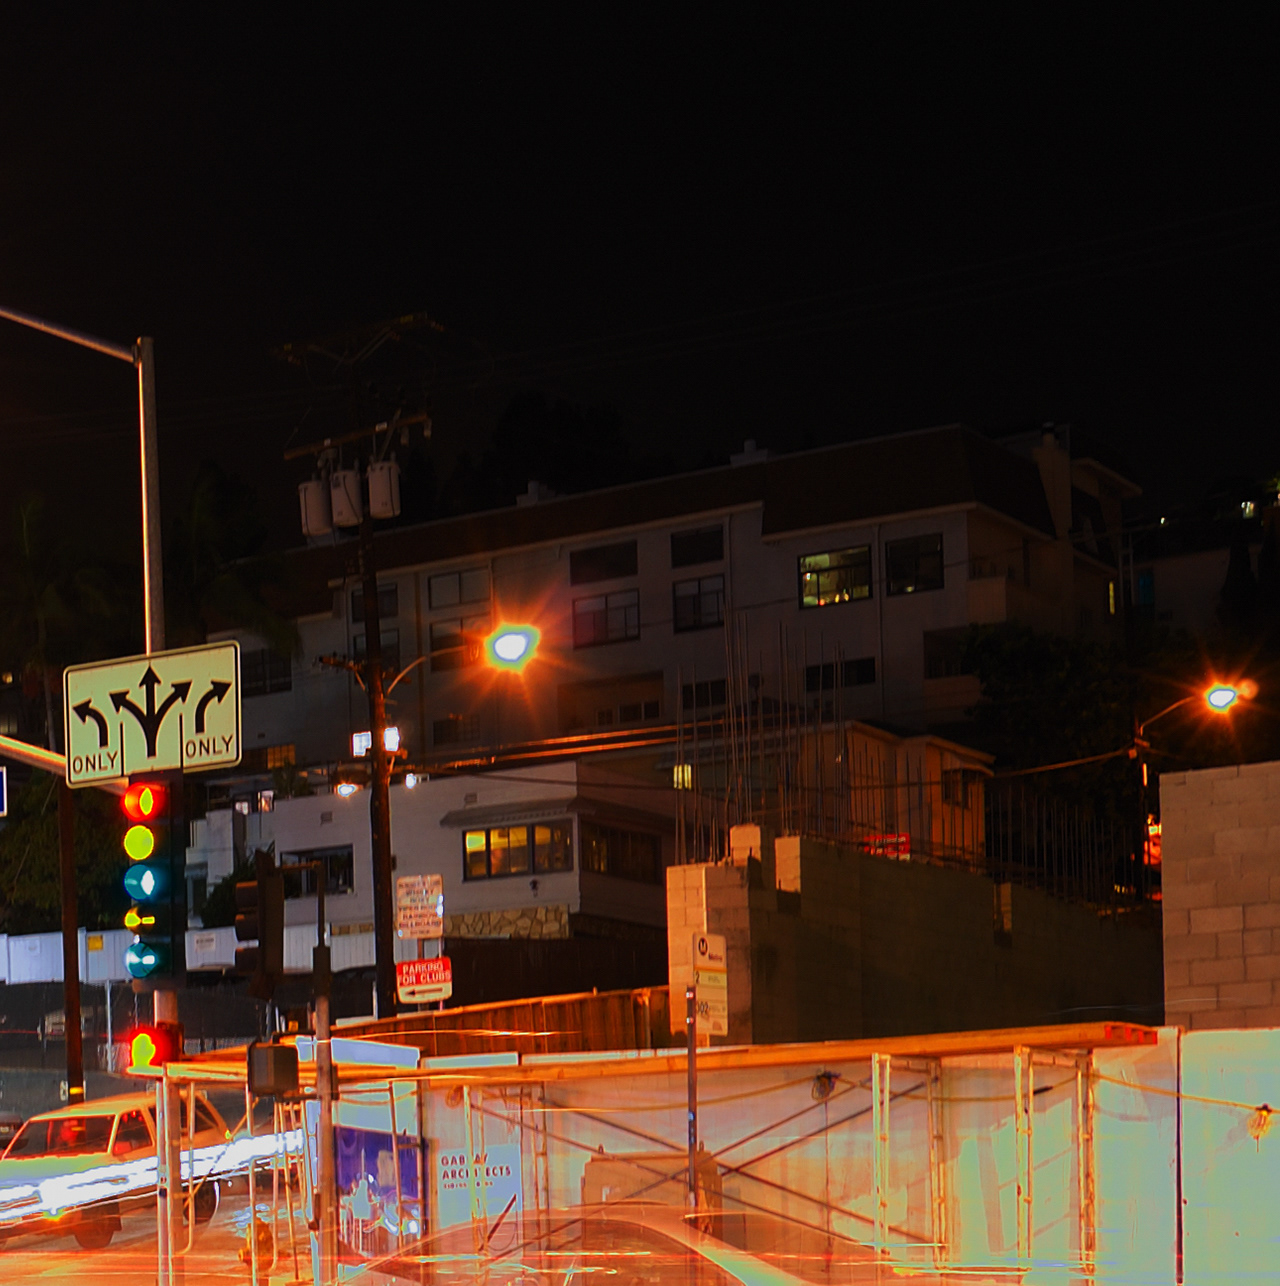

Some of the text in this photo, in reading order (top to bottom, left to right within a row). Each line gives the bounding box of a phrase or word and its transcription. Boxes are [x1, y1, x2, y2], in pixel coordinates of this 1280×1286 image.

[185, 733, 234, 759] ONLY
[72, 750, 118, 775] ONLY
[402, 962, 444, 974] PARKING
